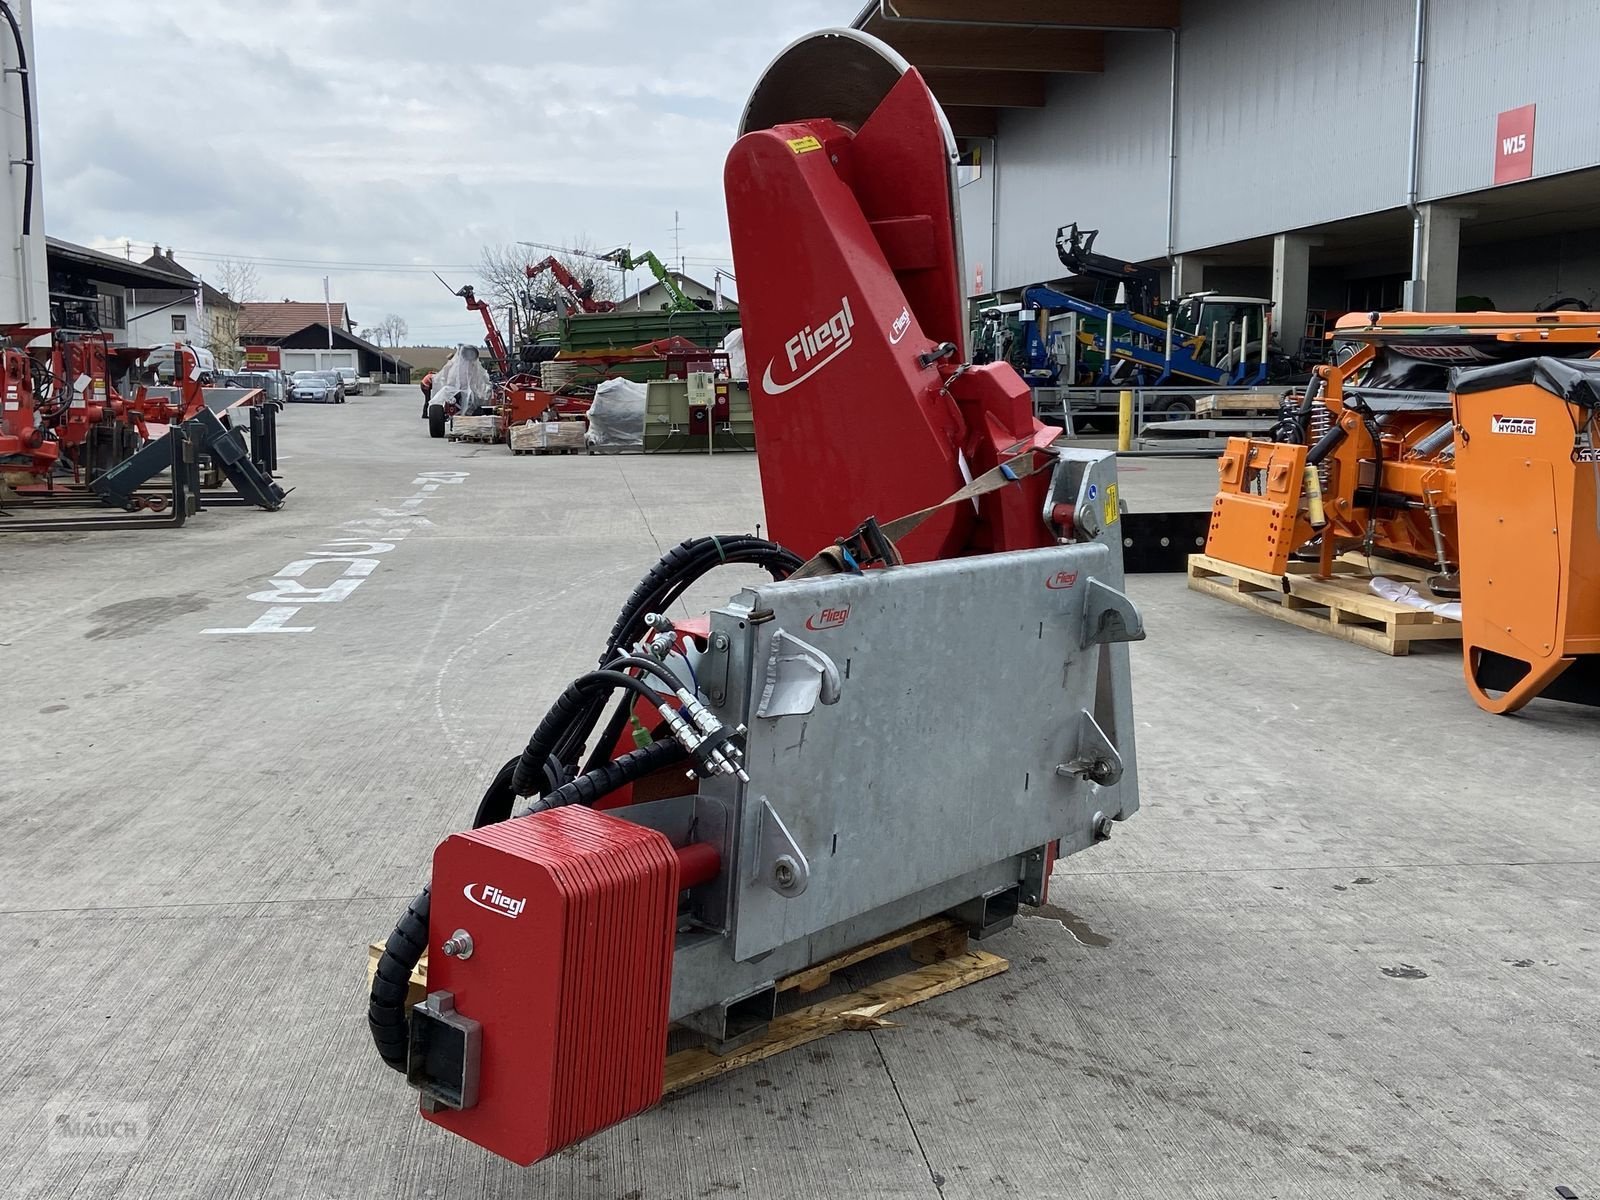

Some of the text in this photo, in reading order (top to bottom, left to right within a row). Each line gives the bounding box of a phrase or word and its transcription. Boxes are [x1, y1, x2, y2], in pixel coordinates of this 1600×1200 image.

[1503, 134, 1526, 156] W15
[892, 306, 911, 335] Fliegl
[784, 295, 855, 373] Fliegl
[1498, 424, 1534, 434] HYDRAC
[1055, 570, 1079, 585] Fliegl
[819, 602, 851, 624] Fliegl
[481, 884, 527, 916] Fliegl
